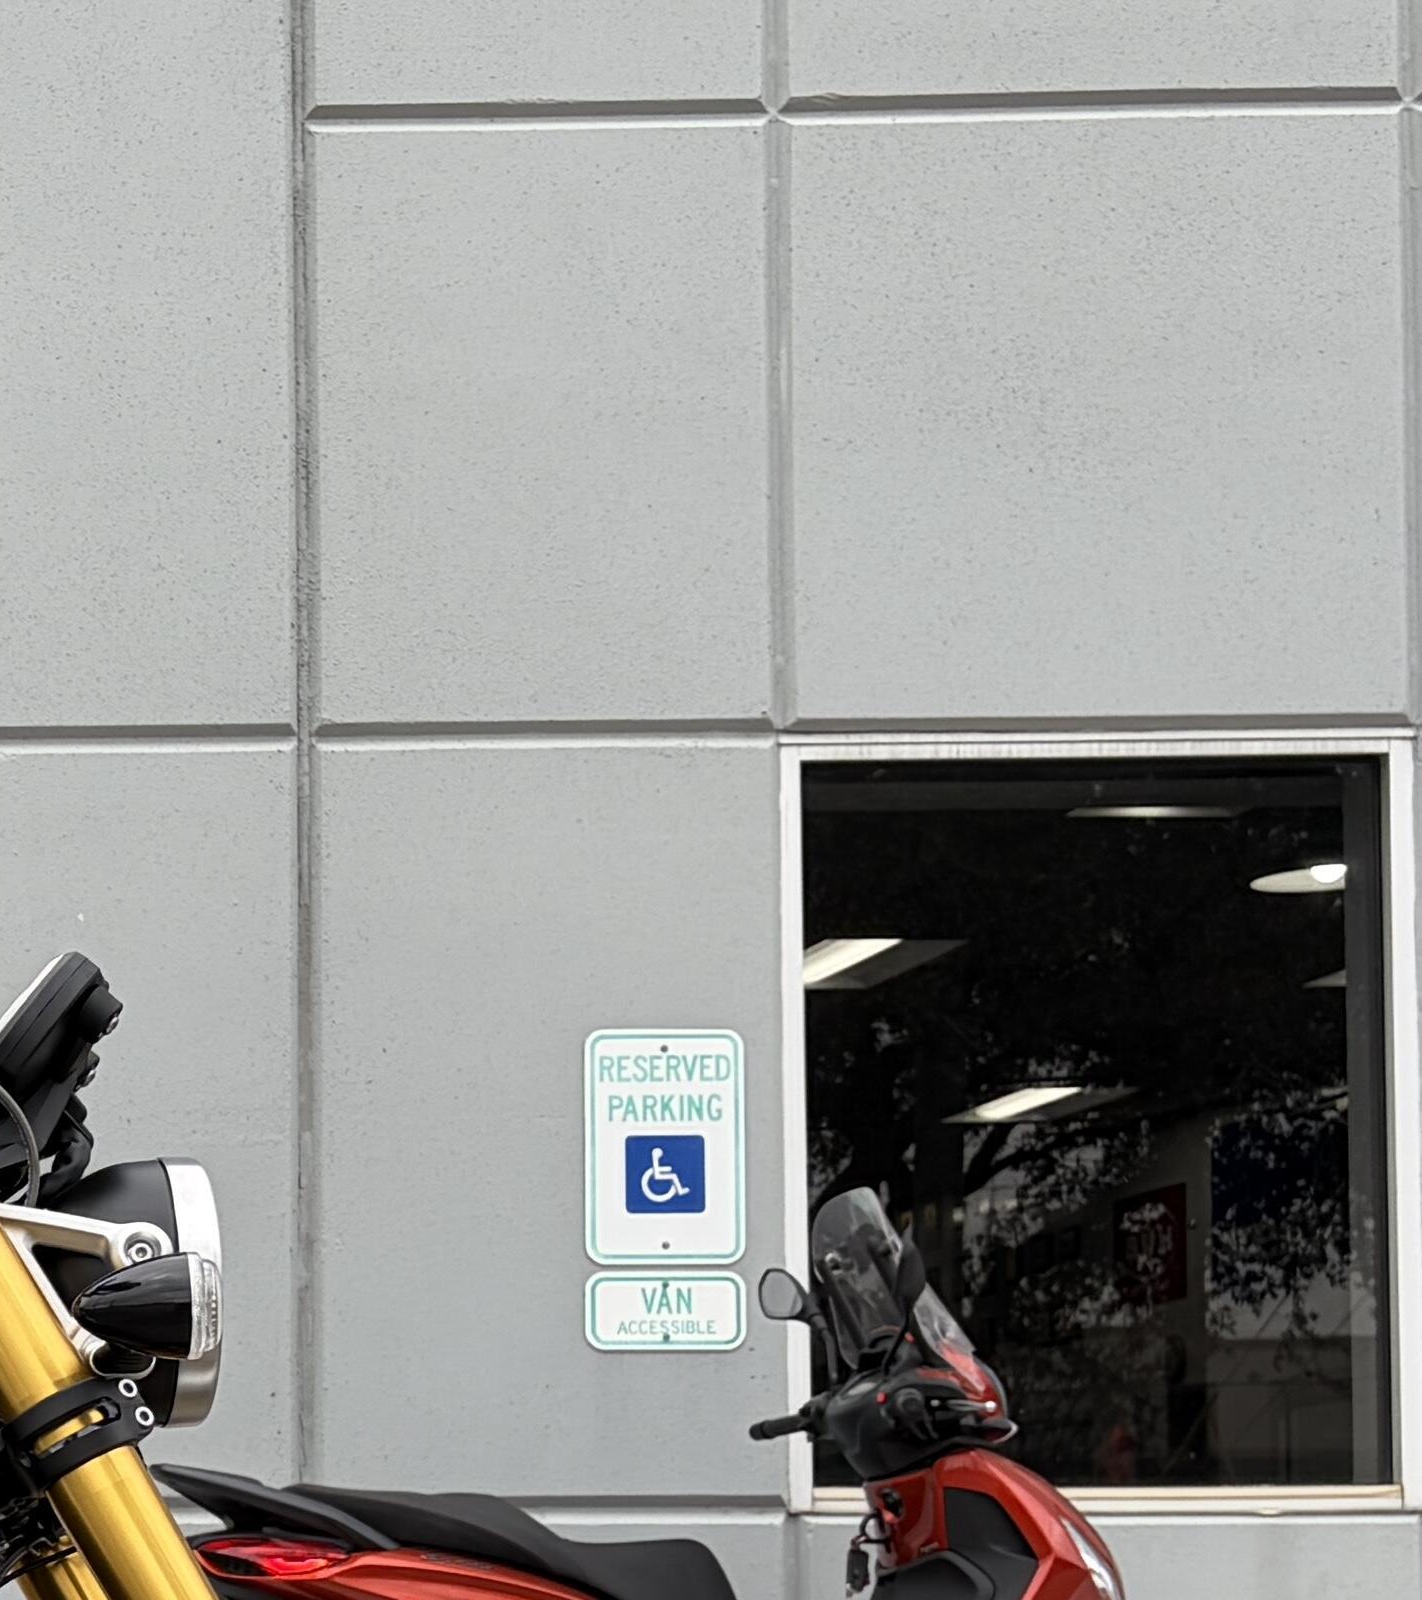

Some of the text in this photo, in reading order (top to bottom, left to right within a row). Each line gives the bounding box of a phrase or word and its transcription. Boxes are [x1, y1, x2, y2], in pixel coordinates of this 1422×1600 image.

[598, 1054, 732, 1083] RESERVED
[607, 1093, 723, 1123] PARKING
[641, 1286, 694, 1315] VAN
[616, 1319, 717, 1336] ACCESSIBLE
